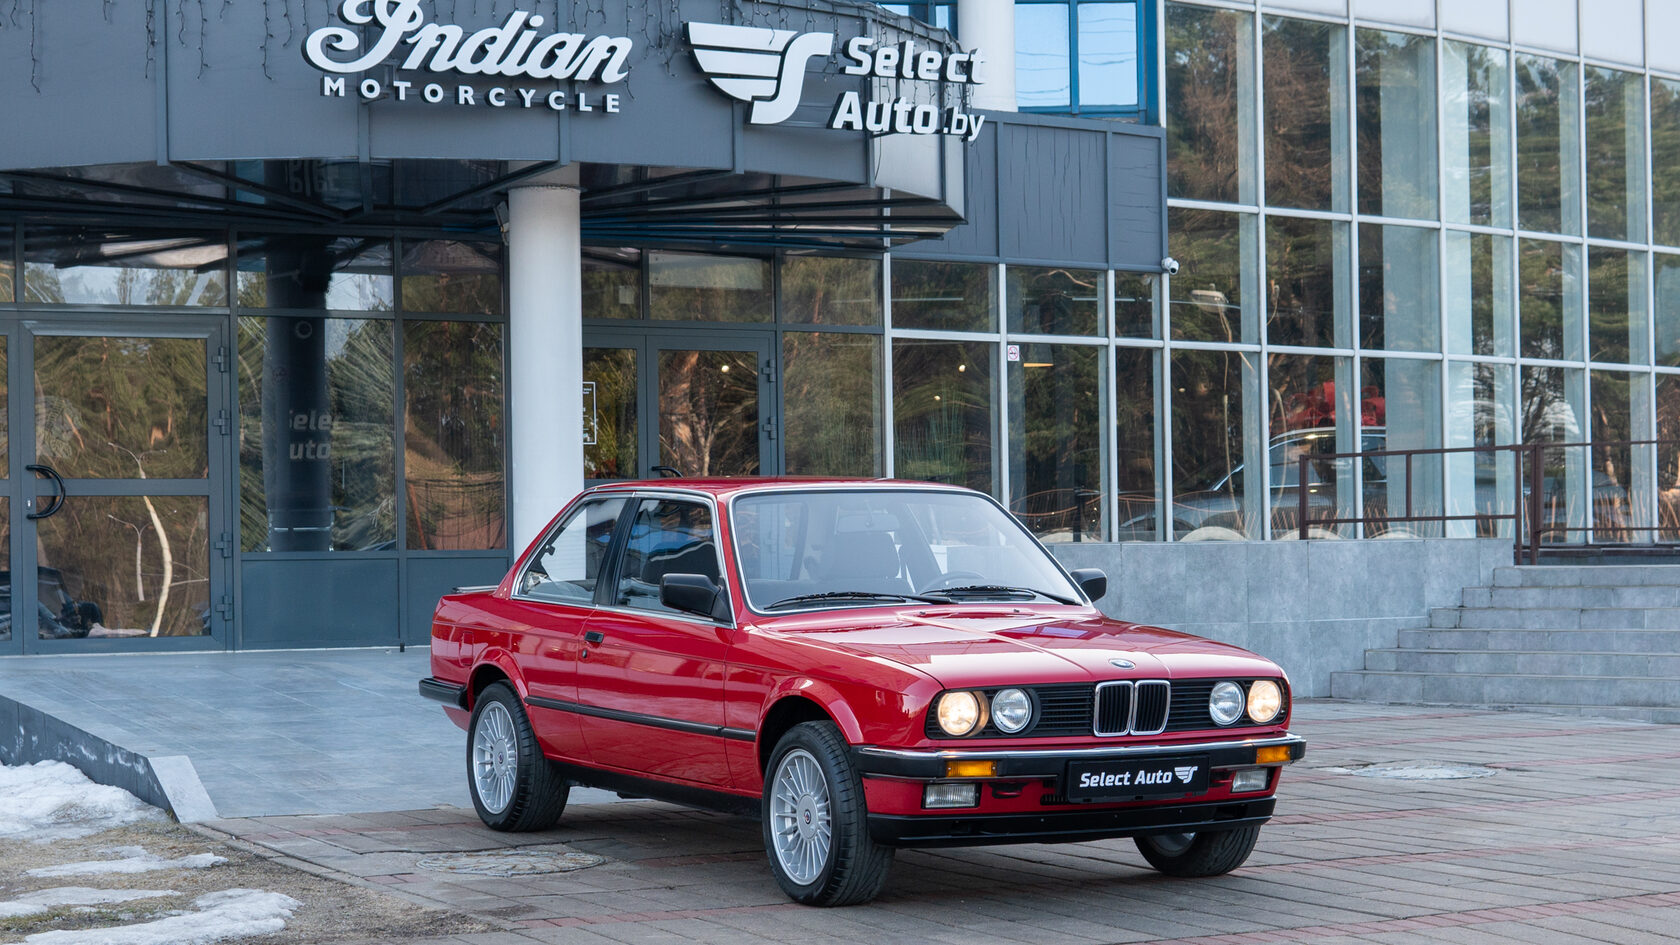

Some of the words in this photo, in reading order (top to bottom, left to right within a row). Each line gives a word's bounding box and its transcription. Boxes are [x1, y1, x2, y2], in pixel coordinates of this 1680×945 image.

[305, 0, 633, 83] Indian
[844, 36, 987, 84] Select
[323, 76, 621, 113] MOTORCYCLE
[832, 91, 986, 141] Auto.by
[289, 440, 332, 460] uto
[1080, 771, 1132, 788] Select
[1134, 769, 1173, 785] Auto
